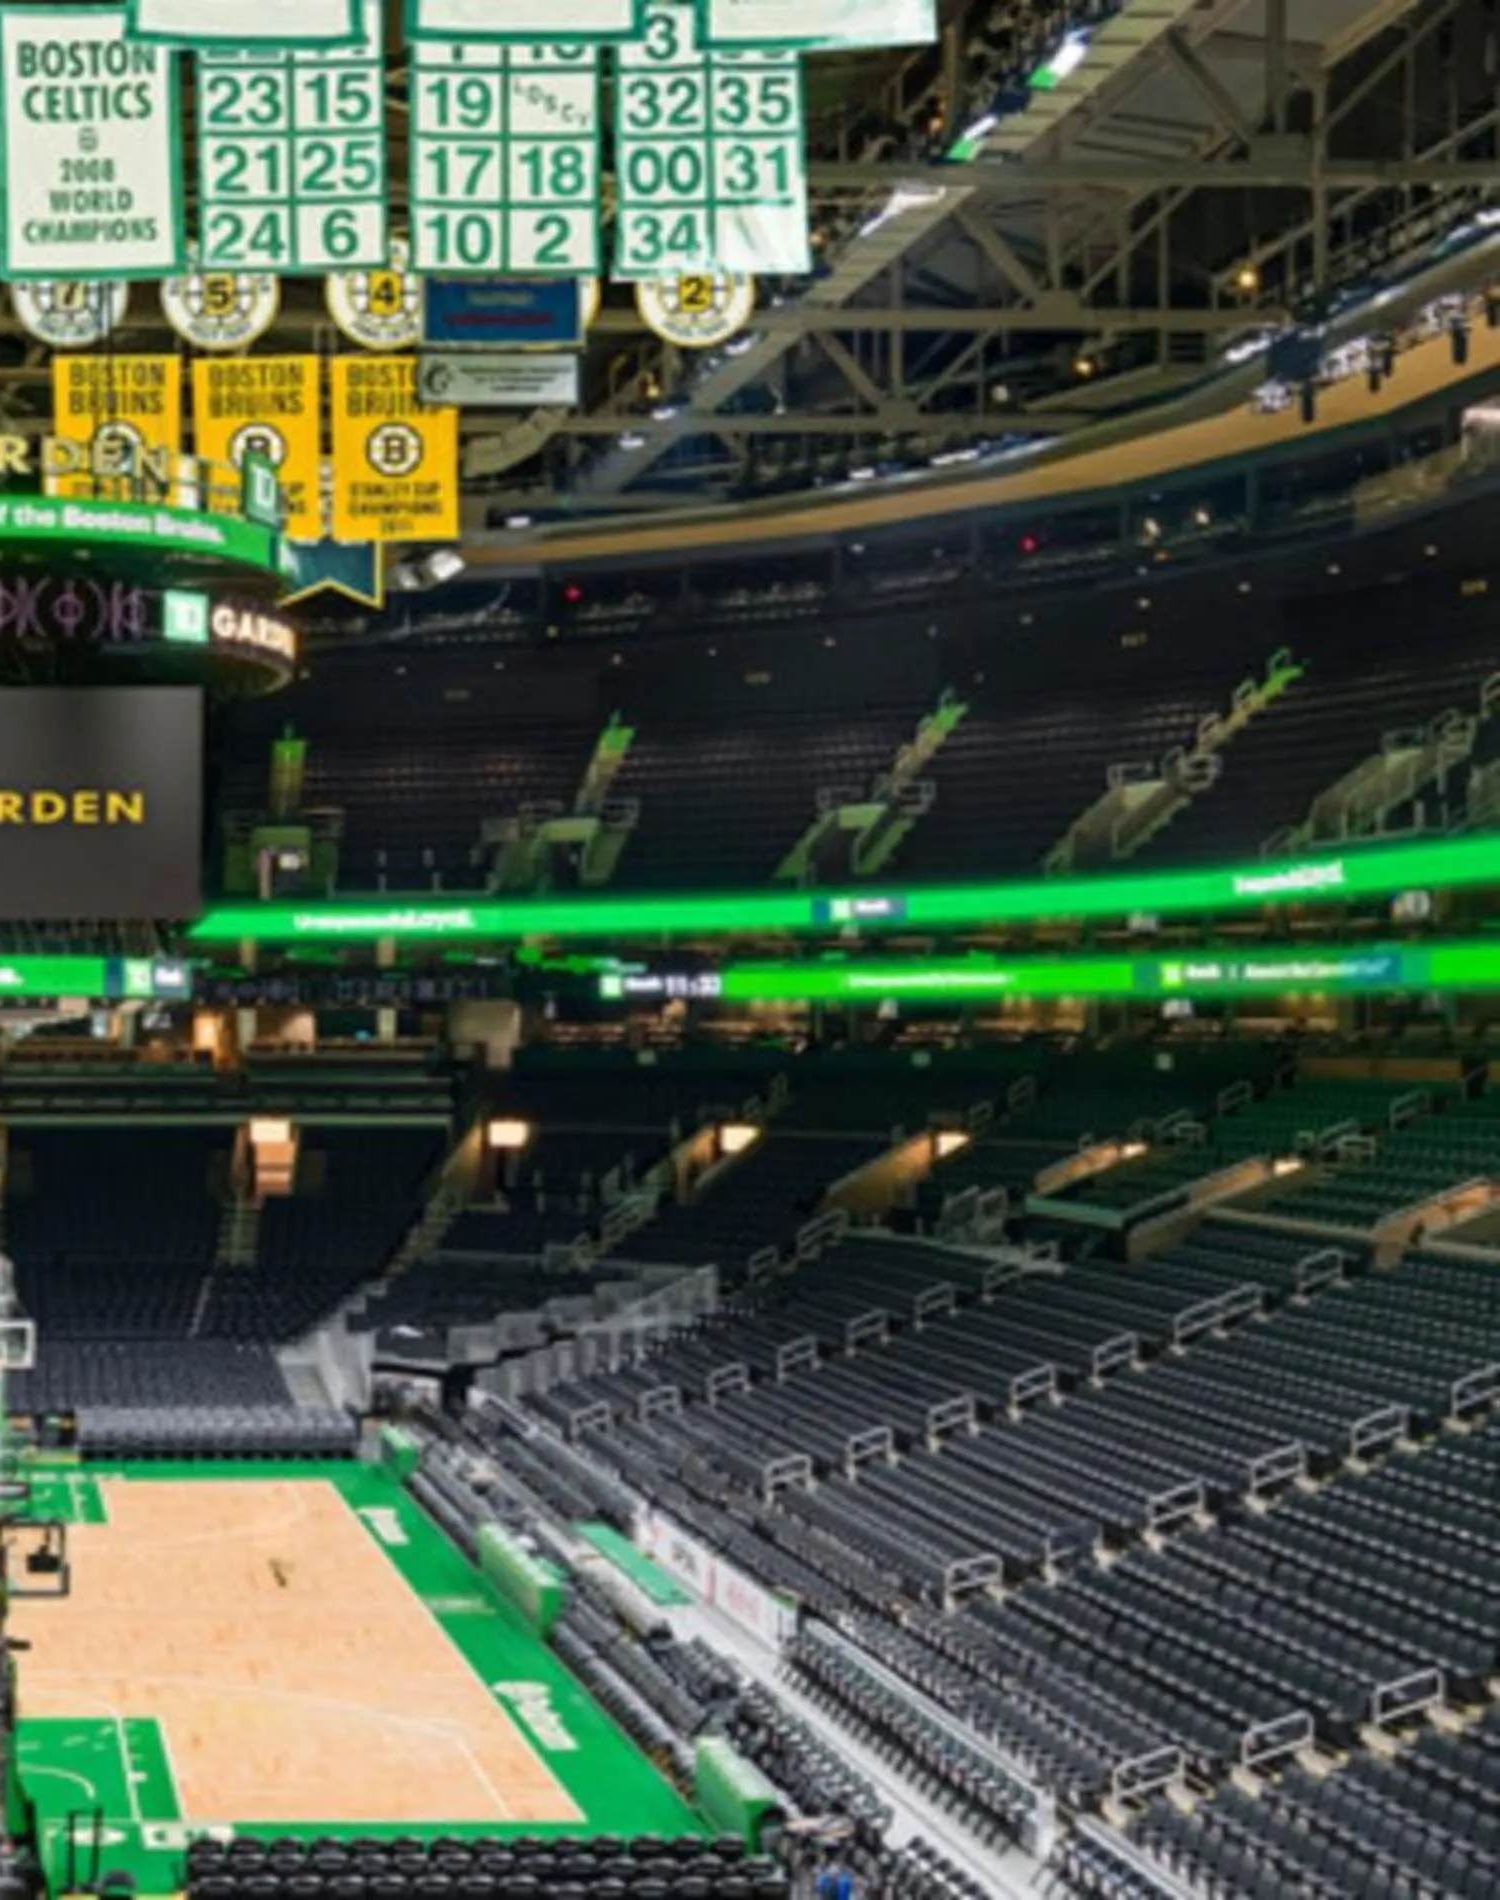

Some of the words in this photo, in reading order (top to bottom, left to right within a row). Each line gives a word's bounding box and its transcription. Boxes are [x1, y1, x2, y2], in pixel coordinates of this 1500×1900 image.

[645, 13, 678, 60] 3
[16, 40, 156, 78] BOSTON
[22, 82, 152, 122] CELTICS
[207, 75, 282, 124] 23
[303, 73, 372, 123] 15
[425, 77, 493, 128] 19
[628, 77, 699, 128] 32
[717, 76, 791, 126] 35
[60, 157, 116, 183] 2008
[213, 144, 279, 193] 21
[302, 141, 376, 190] 25
[425, 146, 494, 197] 17
[518, 146, 585, 197] 18
[628, 145, 703, 195] 00
[724, 144, 788, 194] 31
[49, 188, 133, 213] WORLD
[22, 218, 158, 244] CHAMPIONS
[208, 211, 285, 261] 24
[321, 208, 358, 259] 6
[424, 213, 493, 265] 10
[534, 213, 570, 265] 2
[630, 212, 701, 264] 34
[207, 279, 229, 305] 5
[373, 278, 396, 304] 4
[683, 278, 707, 305] 2
[68, 362, 164, 388] BOSTON
[208, 363, 304, 388] BOSTON
[13, 505, 56, 528] the
